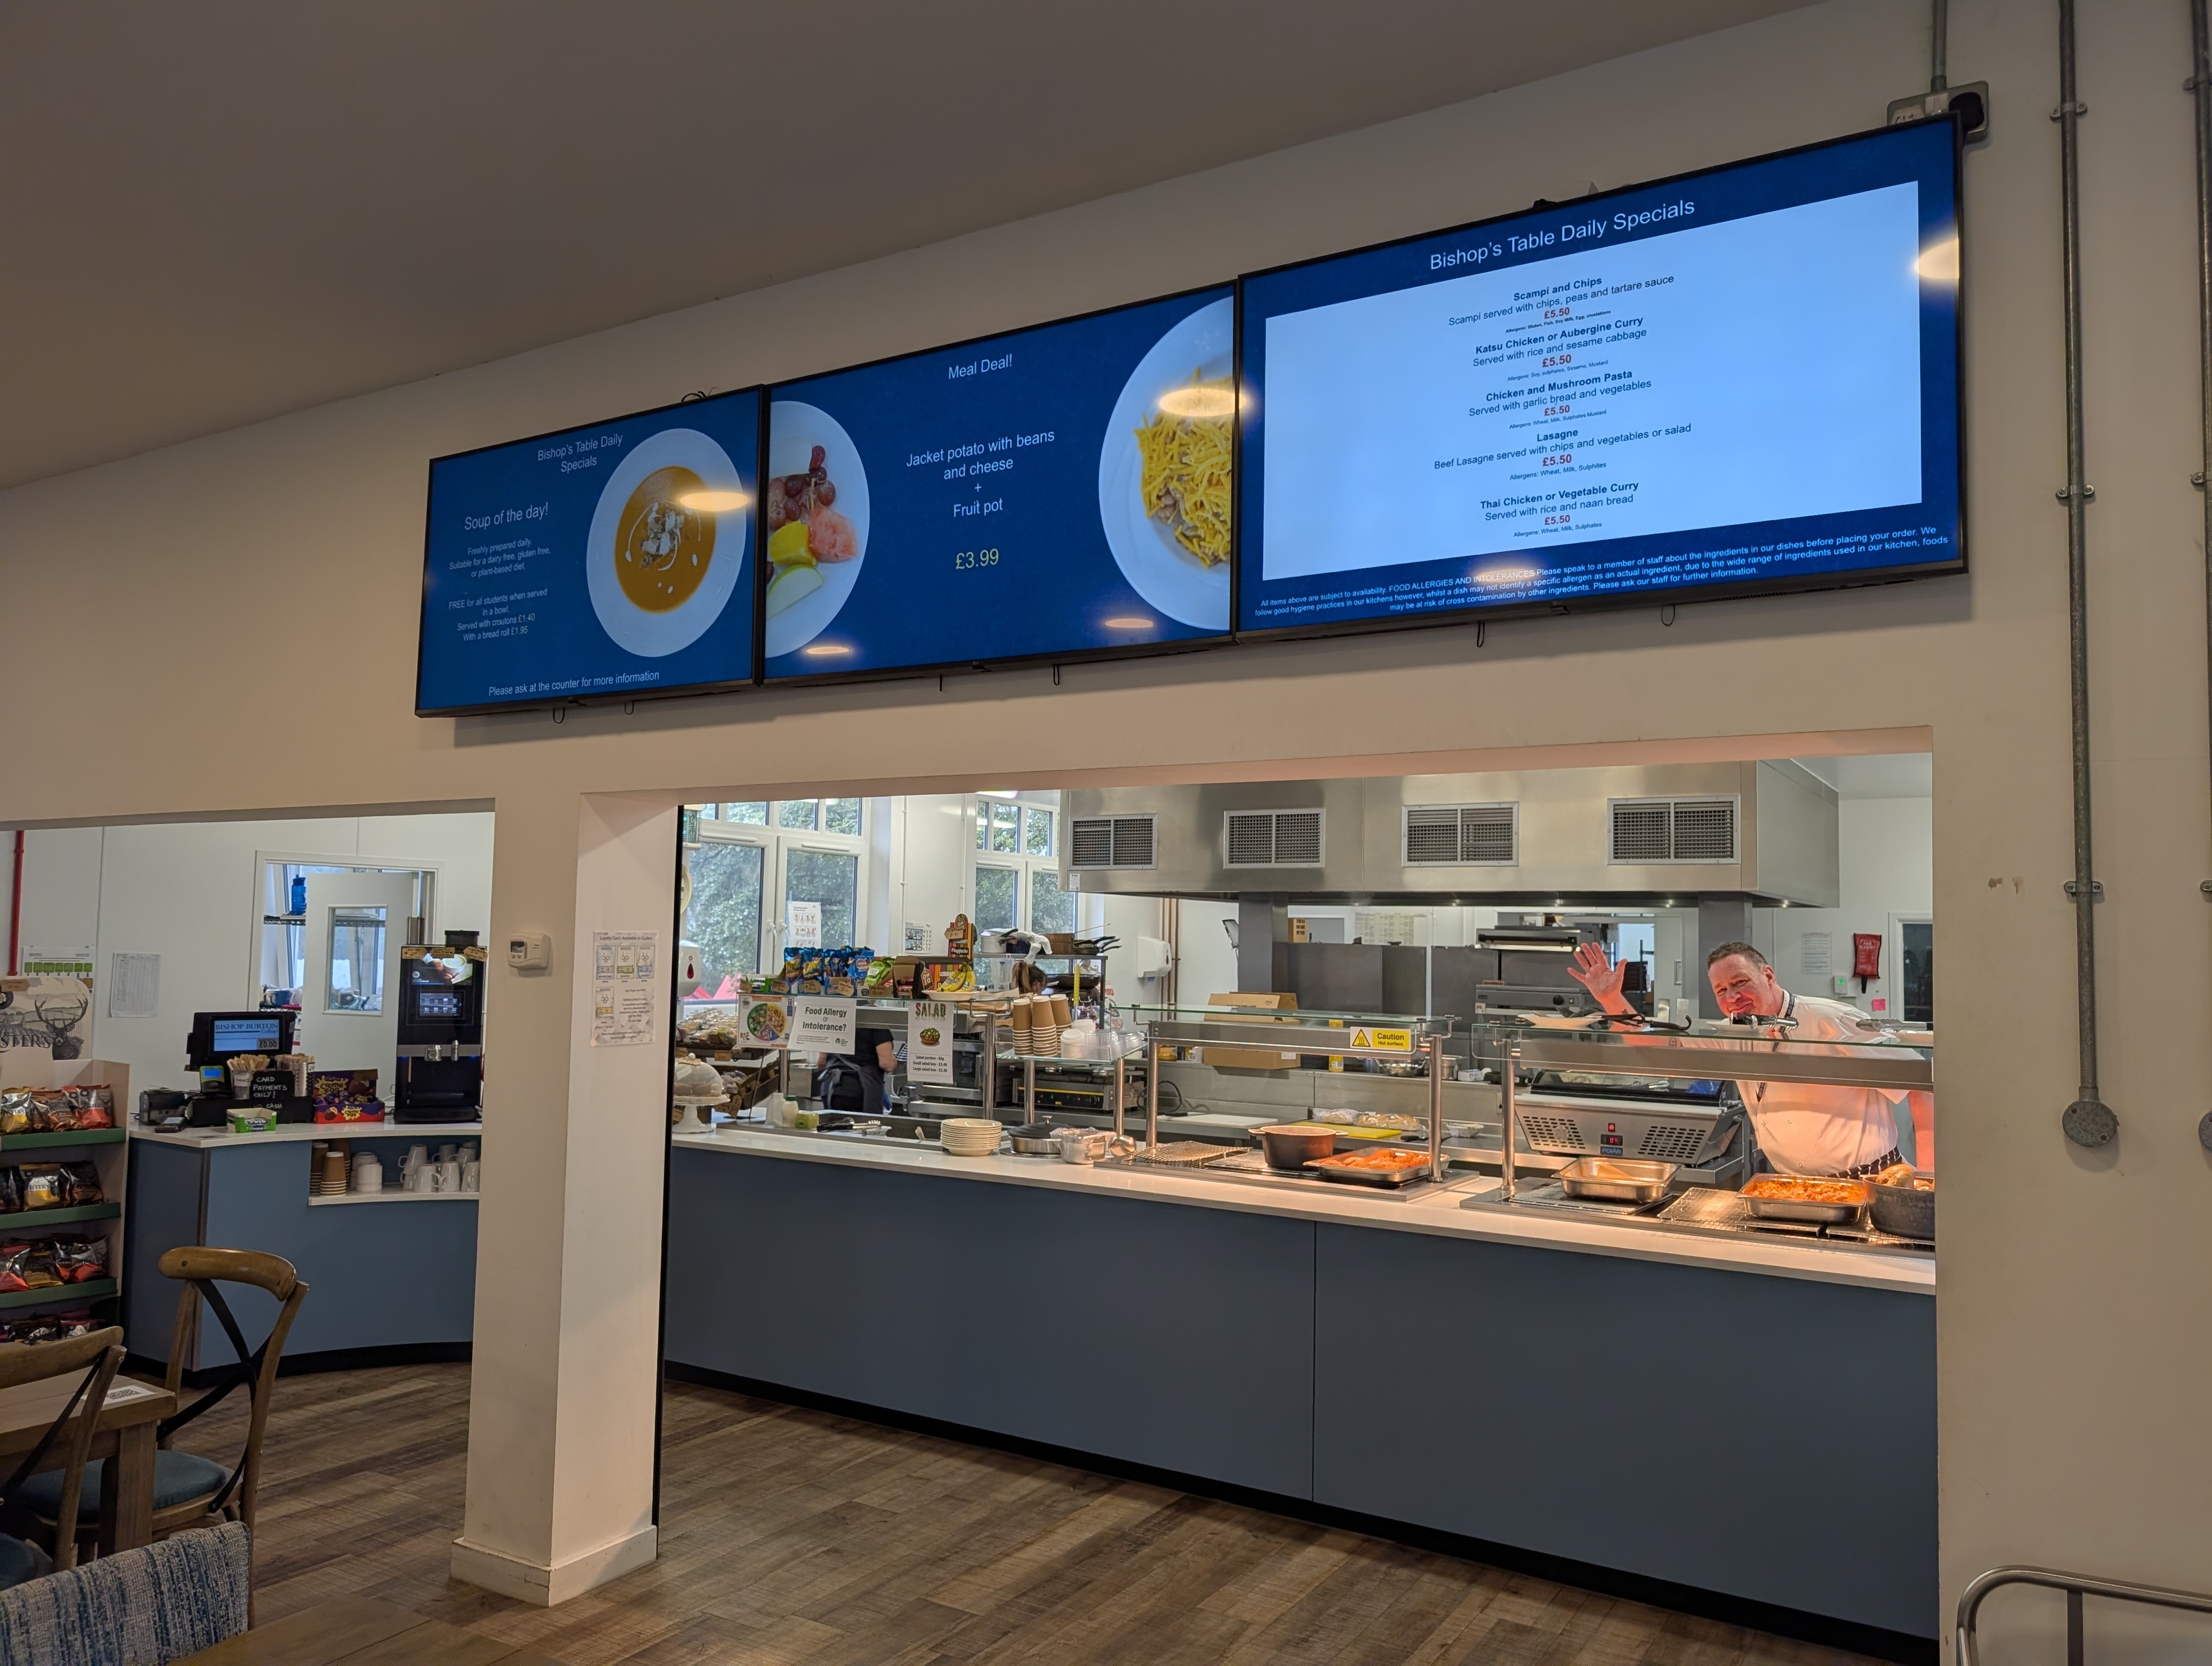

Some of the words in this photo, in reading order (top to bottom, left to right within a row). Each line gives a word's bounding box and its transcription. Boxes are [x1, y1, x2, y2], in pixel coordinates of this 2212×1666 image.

[1430, 242, 1502, 270] Bishop's
[1507, 230, 1555, 253] Table
[1561, 219, 1607, 242] Daily
[1613, 200, 1695, 232] Specials
[1513, 286, 1549, 302] Scampi
[1552, 281, 1571, 294] and
[1573, 278, 1602, 290] Chips
[1544, 306, 1570, 319] £5.50
[1476, 343, 1503, 355] Katsu
[1505, 336, 1545, 349] Chicken
[1547, 333, 1558, 341] or
[1560, 323, 1612, 339] Aubergine
[1615, 317, 1644, 329] Curry
[948, 361, 977, 380] Meal
[981, 353, 1013, 373] Deal!
[1542, 354, 1572, 368] £5.50
[1486, 389, 1525, 402] Chicken
[1527, 383, 1545, 395] and
[1548, 376, 1601, 392] Mushroom
[1604, 370, 1632, 382] Pasta
[1544, 404, 1570, 416] £5.50
[1536, 430, 1579, 442] Lasagne
[537, 444, 573, 462] Bishop's
[575, 438, 599, 453] Table
[600, 433, 623, 448] Daily
[906, 448, 944, 467] Jacket
[947, 443, 985, 463] potato
[988, 436, 1013, 452] with
[1017, 431, 1054, 447] beans
[561, 455, 597, 474] Specials
[943, 463, 966, 480] and
[969, 458, 1013, 476] cheese
[1542, 453, 1572, 467] £5.50
[1480, 498, 1501, 510] Thai
[1503, 495, 1543, 507] Chicken
[1545, 493, 1557, 501] or
[1558, 485, 1607, 500] Vegetable
[1610, 482, 1639, 492] Curry
[464, 516, 491, 530] Soup
[493, 509, 505, 525] of
[506, 508, 523, 523] the
[525, 501, 549, 521] day!
[953, 499, 981, 517] Fruit
[983, 498, 1003, 516] pot
[1544, 514, 1571, 526] £5.50
[467, 545, 489, 556] Freshly
[489, 540, 517, 554] prepared
[448, 559, 472, 571] Suitable
[473, 558, 482, 566] for
[487, 554, 502, 564] dairy
[517, 549, 536, 561] gluten
[955, 548, 999, 570] £3.99
[478, 563, 513, 579] plant-based
[1437, 598, 1445, 606] of
[1466, 592, 1516, 603] contamination
[1517, 590, 1527, 599] by
[1528, 588, 1547, 597] other
[1548, 584, 1591, 595] ingredients.
[1593, 581, 1620, 589] Please
[1621, 579, 1635, 587] ask
[1651, 575, 1669, 584] staff
[1682, 572, 1709, 581] further
[1711, 567, 1758, 578] information.
[448, 599, 466, 610] FREE
[466, 599, 475, 607] for
[475, 597, 483, 606] all
[483, 594, 509, 605] students
[509, 592, 526, 601] when
[526, 587, 548, 599] served
[457, 620, 478, 631] Served
[478, 619, 491, 628] with
[491, 617, 517, 626] croutons
[518, 612, 536, 623] £1.40
[482, 608, 488, 616] in
[462, 632, 477, 642] With
[482, 629, 500, 639] bread
[500, 627, 510, 637] roll
[511, 625, 529, 636] £1.95
[488, 686, 513, 696] Please
[515, 683, 528, 694] ask
[529, 682, 537, 693] at
[538, 681, 550, 691] the
[551, 679, 580, 690] counter
[581, 677, 592, 687] for
[593, 676, 614, 686] more
[615, 670, 660, 684] information
[805, 1007, 822, 1015] Food
[823, 1008, 847, 1018] Allergy
[915, 1002, 946, 1017] SALAD
[802, 1021, 847, 1031] Intolerance?
[1377, 1032, 1404, 1040] Caution
[253, 1091, 276, 1099] ONLY!
